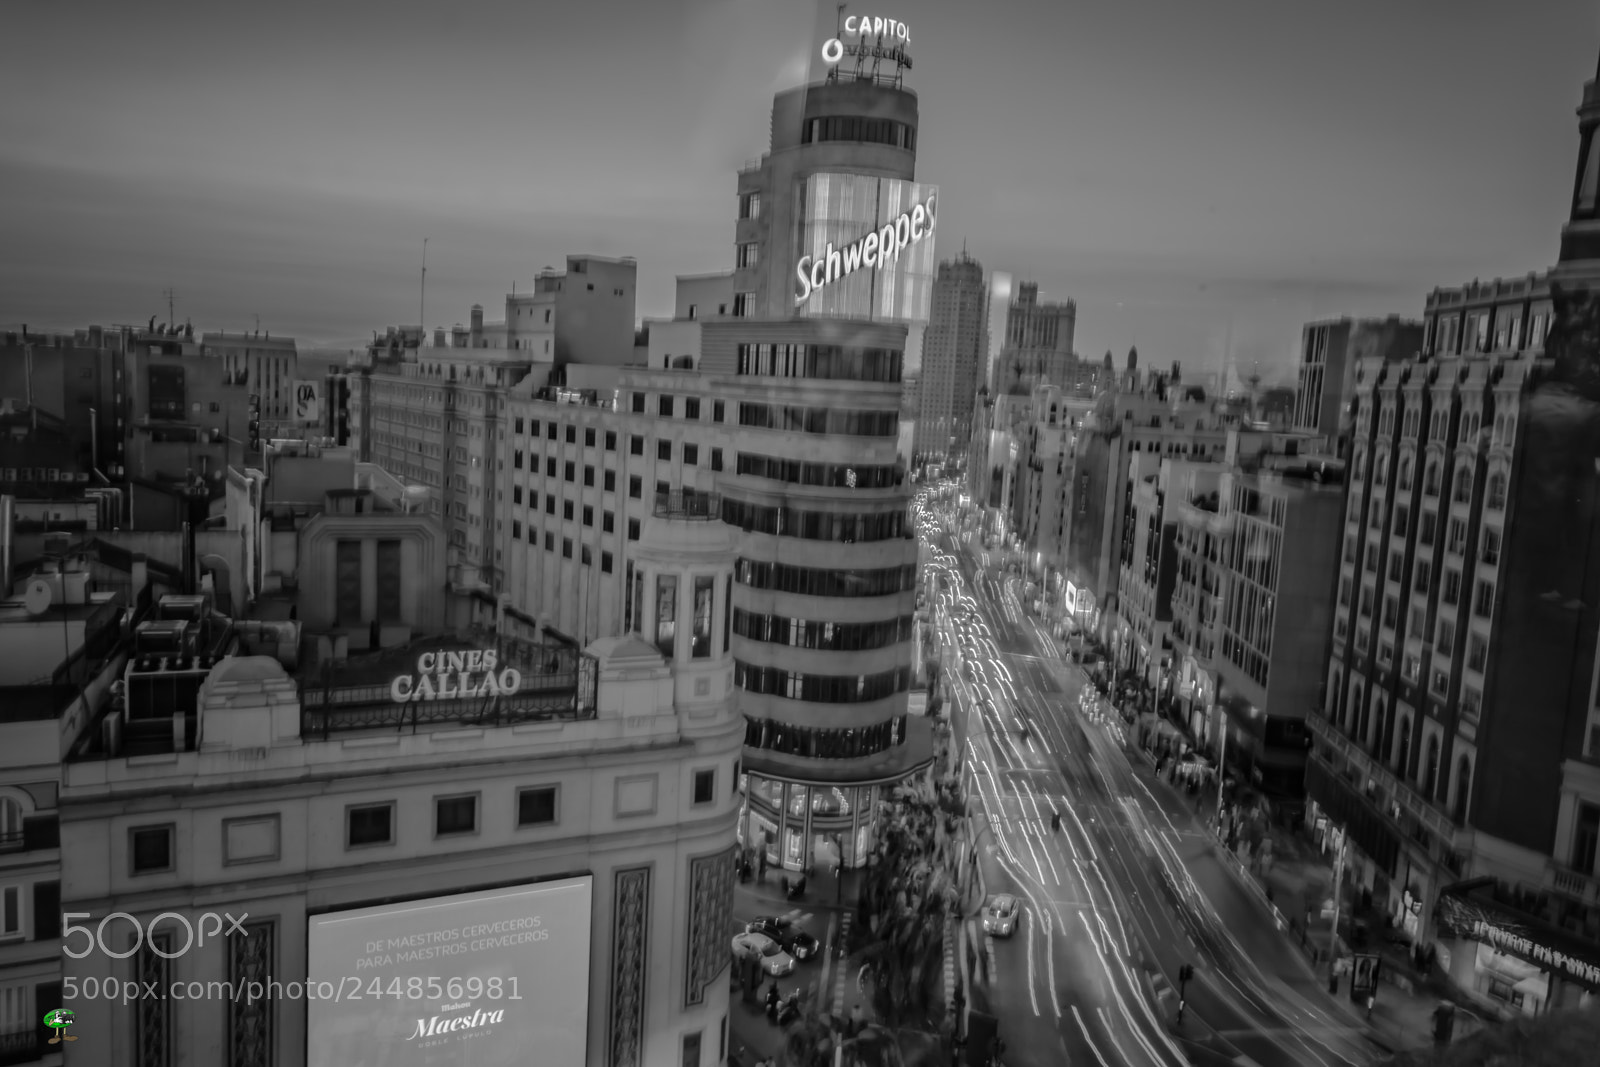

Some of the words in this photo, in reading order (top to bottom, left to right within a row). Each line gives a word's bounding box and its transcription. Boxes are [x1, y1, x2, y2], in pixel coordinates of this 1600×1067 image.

[844, 15, 911, 42] CAPITOL
[795, 195, 936, 303] Schweppes
[417, 649, 498, 674] CINES
[390, 668, 521, 703] CALLAO
[356, 954, 393, 970] PARA
[396, 941, 468, 963] MAESTROS
[471, 928, 550, 951] CERVECEROS
[365, 940, 384, 954] DE
[387, 929, 460, 948] MAESTROS
[462, 915, 542, 938] CERVECEROS
[405, 1007, 505, 1041] Maestra
